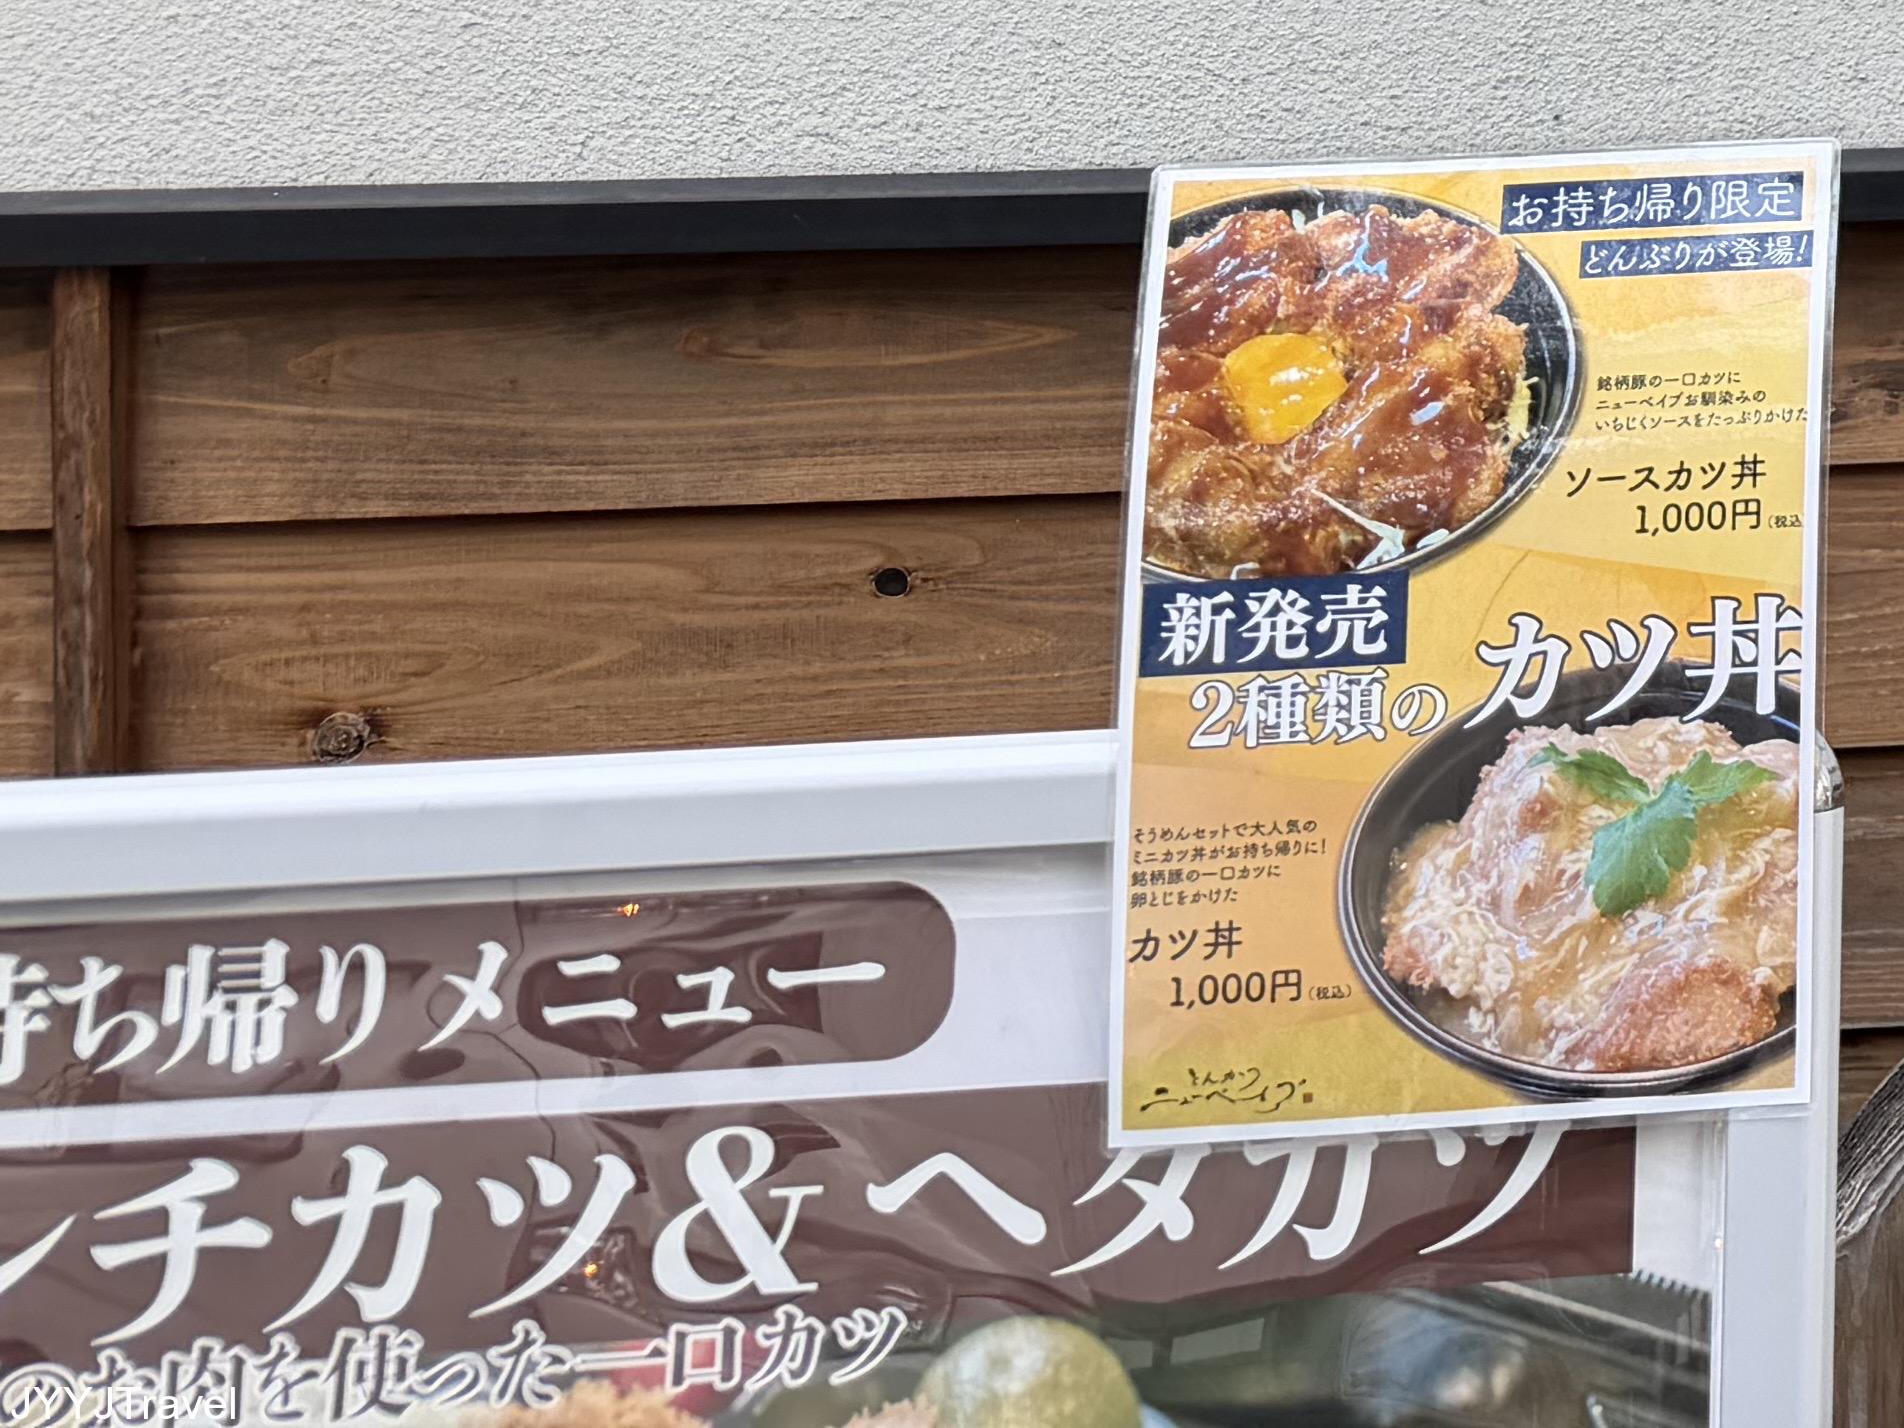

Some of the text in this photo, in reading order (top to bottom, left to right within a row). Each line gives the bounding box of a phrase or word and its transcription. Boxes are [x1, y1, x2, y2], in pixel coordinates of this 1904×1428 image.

[1508, 177, 1795, 228] お持ち帰り限定
[1585, 234, 1807, 275] どんぶりが登場!
[1595, 407, 1809, 432] いちじくソースをたっぷりかけた
[1567, 453, 1767, 497] ソースカツ丼
[1635, 498, 1761, 537] 1,000円
[1160, 582, 1390, 667] 新発売
[1188, 593, 1802, 751] 2種類の カツ丼
[1133, 819, 1317, 845] そうめんセットで大人気の
[1131, 887, 1238, 909] 卵とじをかけた
[1129, 920, 1243, 962] カツ丼
[1170, 969, 1302, 1010] 1,000円
